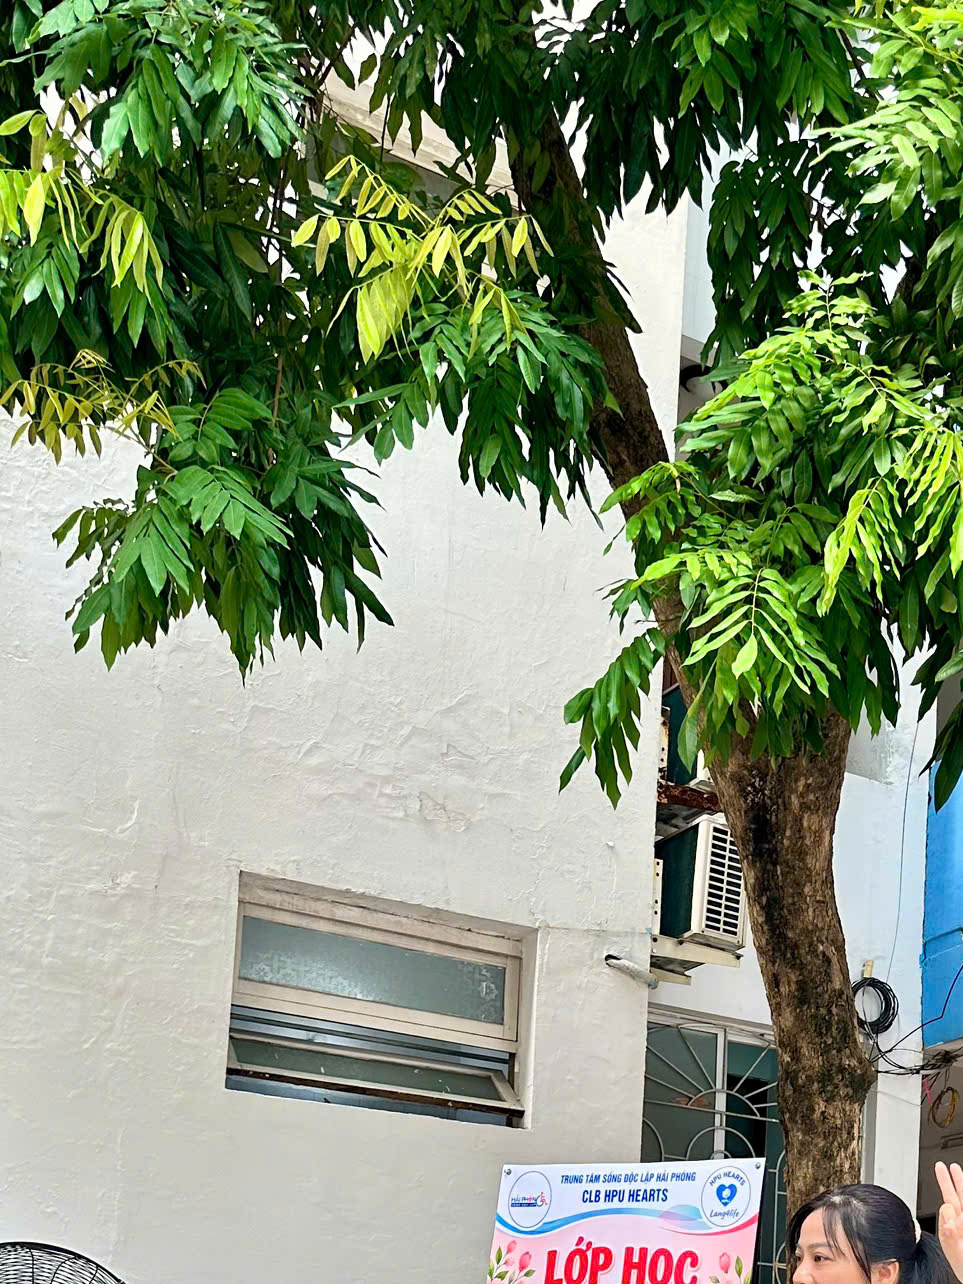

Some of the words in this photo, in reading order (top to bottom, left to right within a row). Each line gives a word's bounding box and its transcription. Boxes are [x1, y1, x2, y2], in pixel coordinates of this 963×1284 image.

[560, 1174, 584, 1184] TRUNG
[582, 1189, 601, 1203] CLB
[604, 1189, 626, 1203] HPU
[627, 1188, 669, 1203] HEARTS
